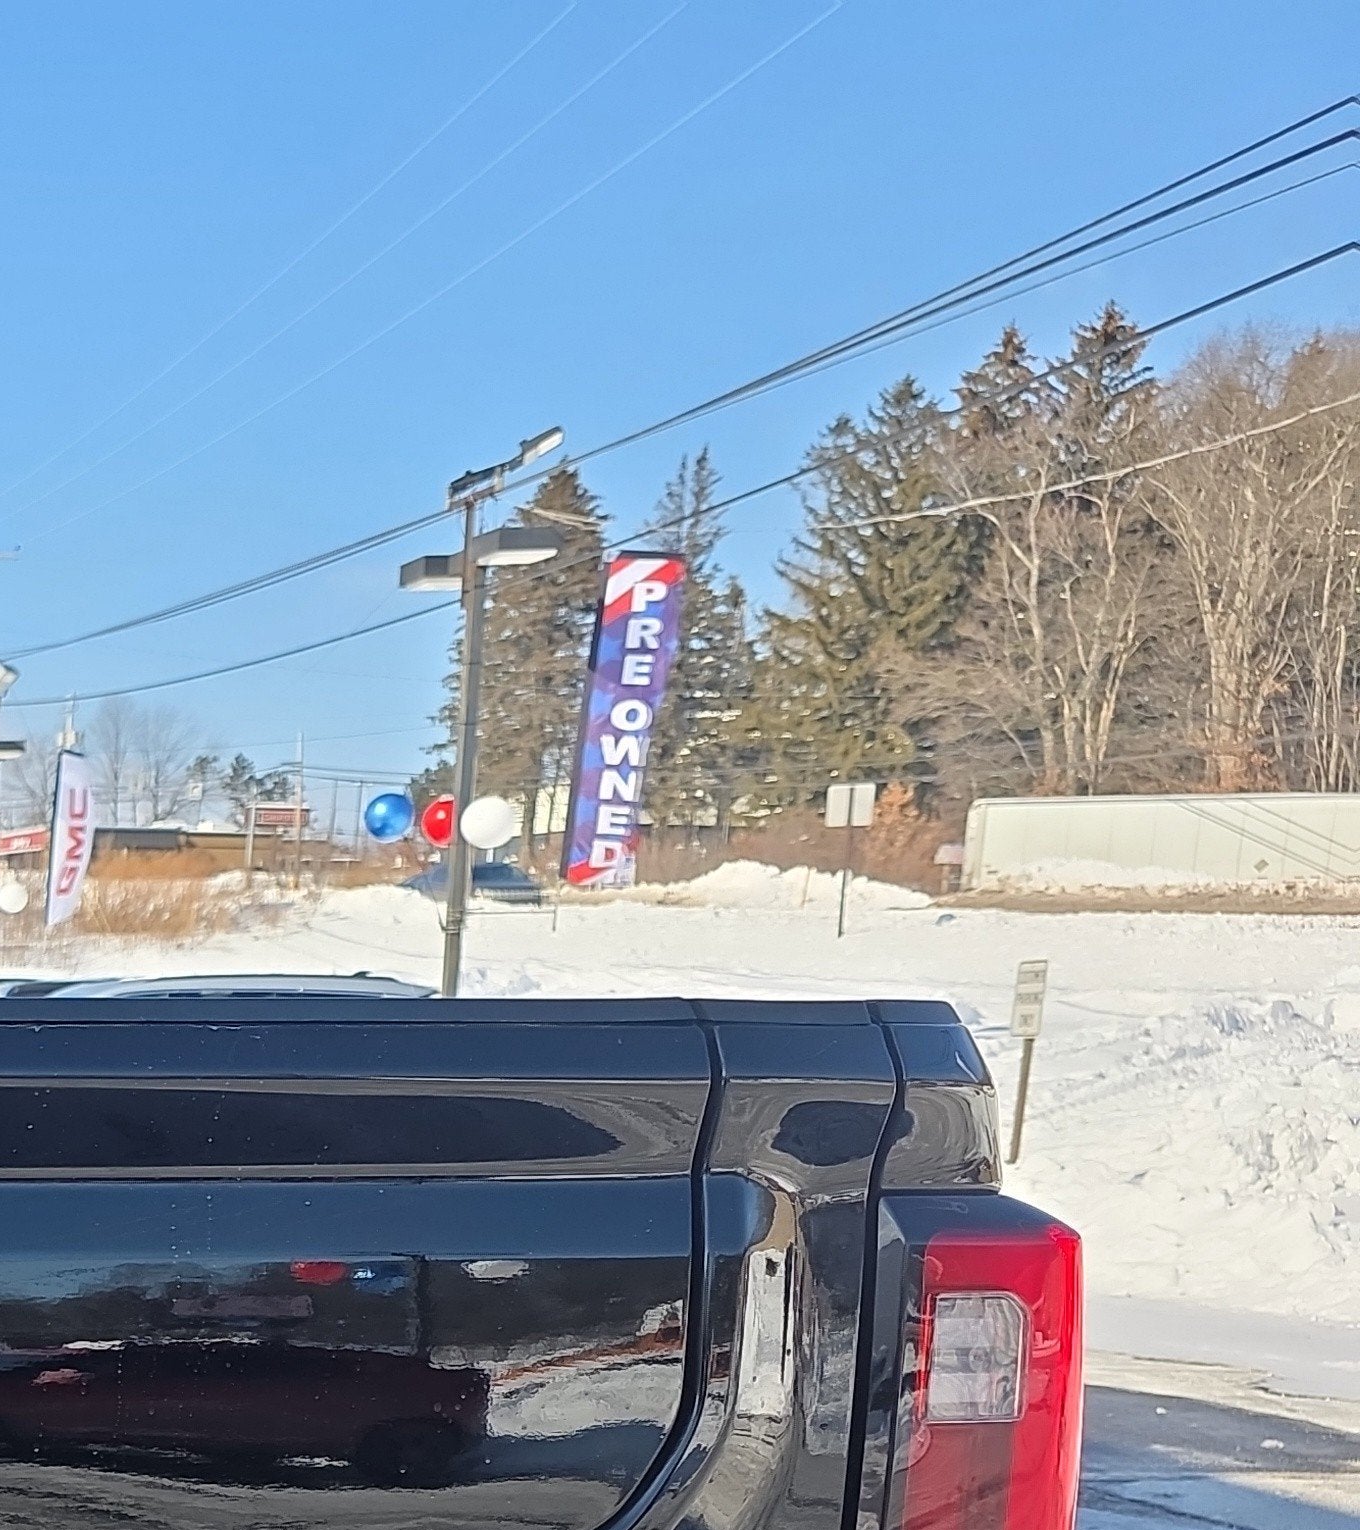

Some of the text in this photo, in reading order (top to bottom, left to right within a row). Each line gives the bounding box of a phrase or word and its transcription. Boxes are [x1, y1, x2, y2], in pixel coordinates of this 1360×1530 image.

[588, 580, 668, 868] PRE OWNED
[56, 788, 88, 896] GMC
